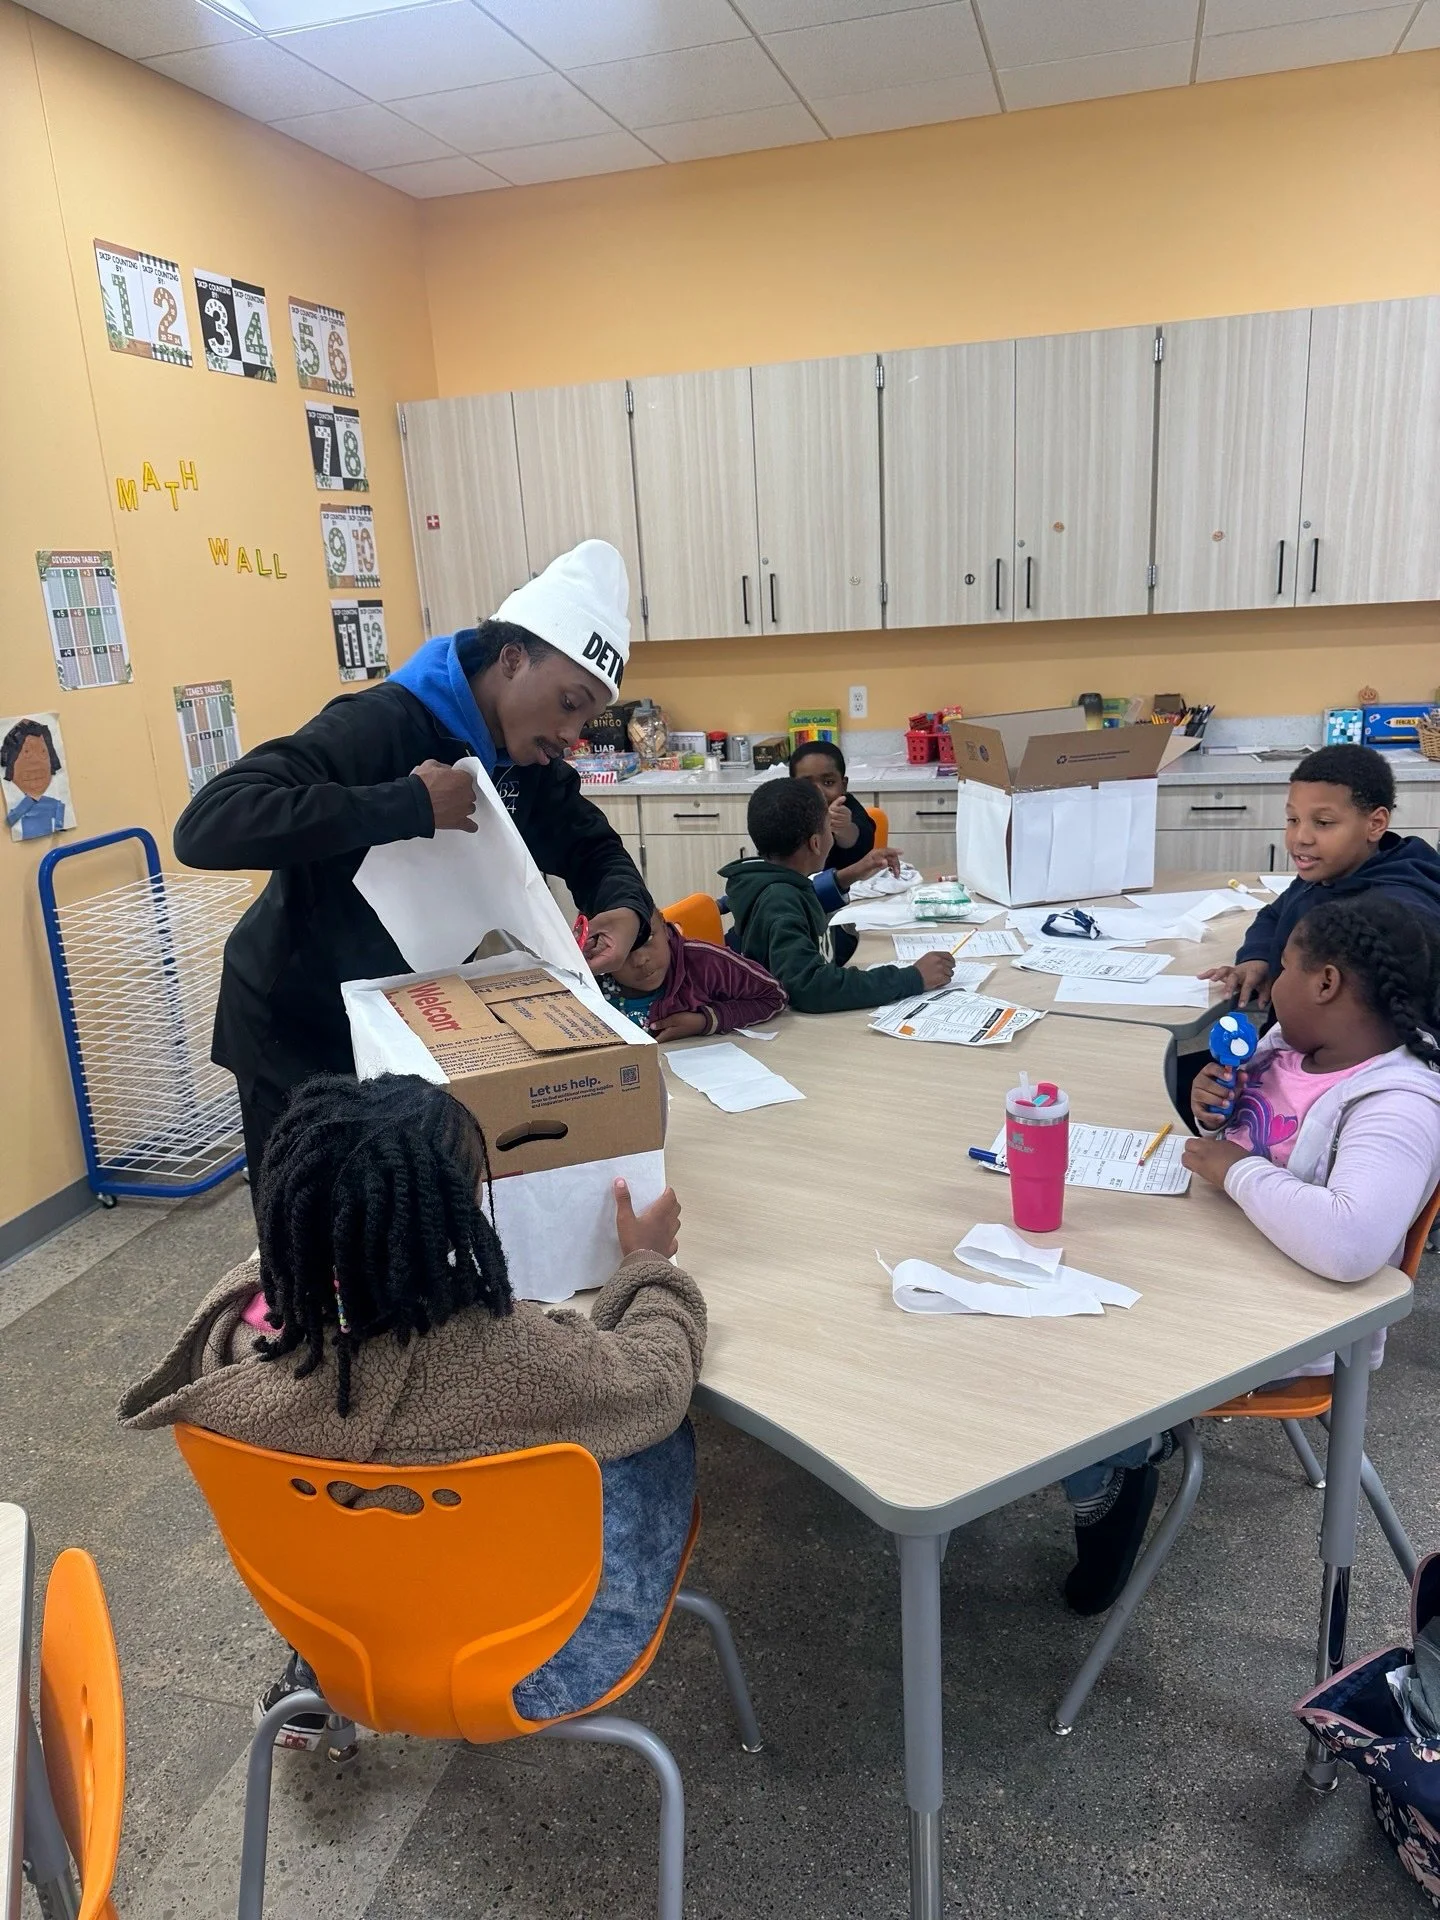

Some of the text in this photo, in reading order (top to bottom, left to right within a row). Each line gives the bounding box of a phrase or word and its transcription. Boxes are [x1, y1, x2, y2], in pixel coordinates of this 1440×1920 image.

[98, 251, 138, 270] SKIP COUNTING
[142, 264, 179, 282] SKIP COUNTING
[111, 273, 134, 337] 1
[196, 280, 232, 296] SKIP COUNTING
[153, 286, 182, 347] 2
[204, 298, 233, 357] 3
[244, 311, 268, 365] 4
[298, 322, 320, 375] 5
[327, 331, 348, 381] 6
[314, 425, 332, 477] 7
[343, 430, 361, 477] 8
[116, 460, 198, 512] MATH
[51, 555, 101, 564] DIVISION TABLES
[208, 538, 287, 579] WALL
[328, 527, 347, 573] 9
[352, 528, 374, 573] 10
[338, 623, 362, 667] 11
[363, 622, 385, 664] 12
[185, 684, 223, 697] TIMES TABLES
[593, 719, 622, 727] BINGO
[594, 744, 615, 753] LIAR
[529, 1076, 601, 1098] Let us help.
